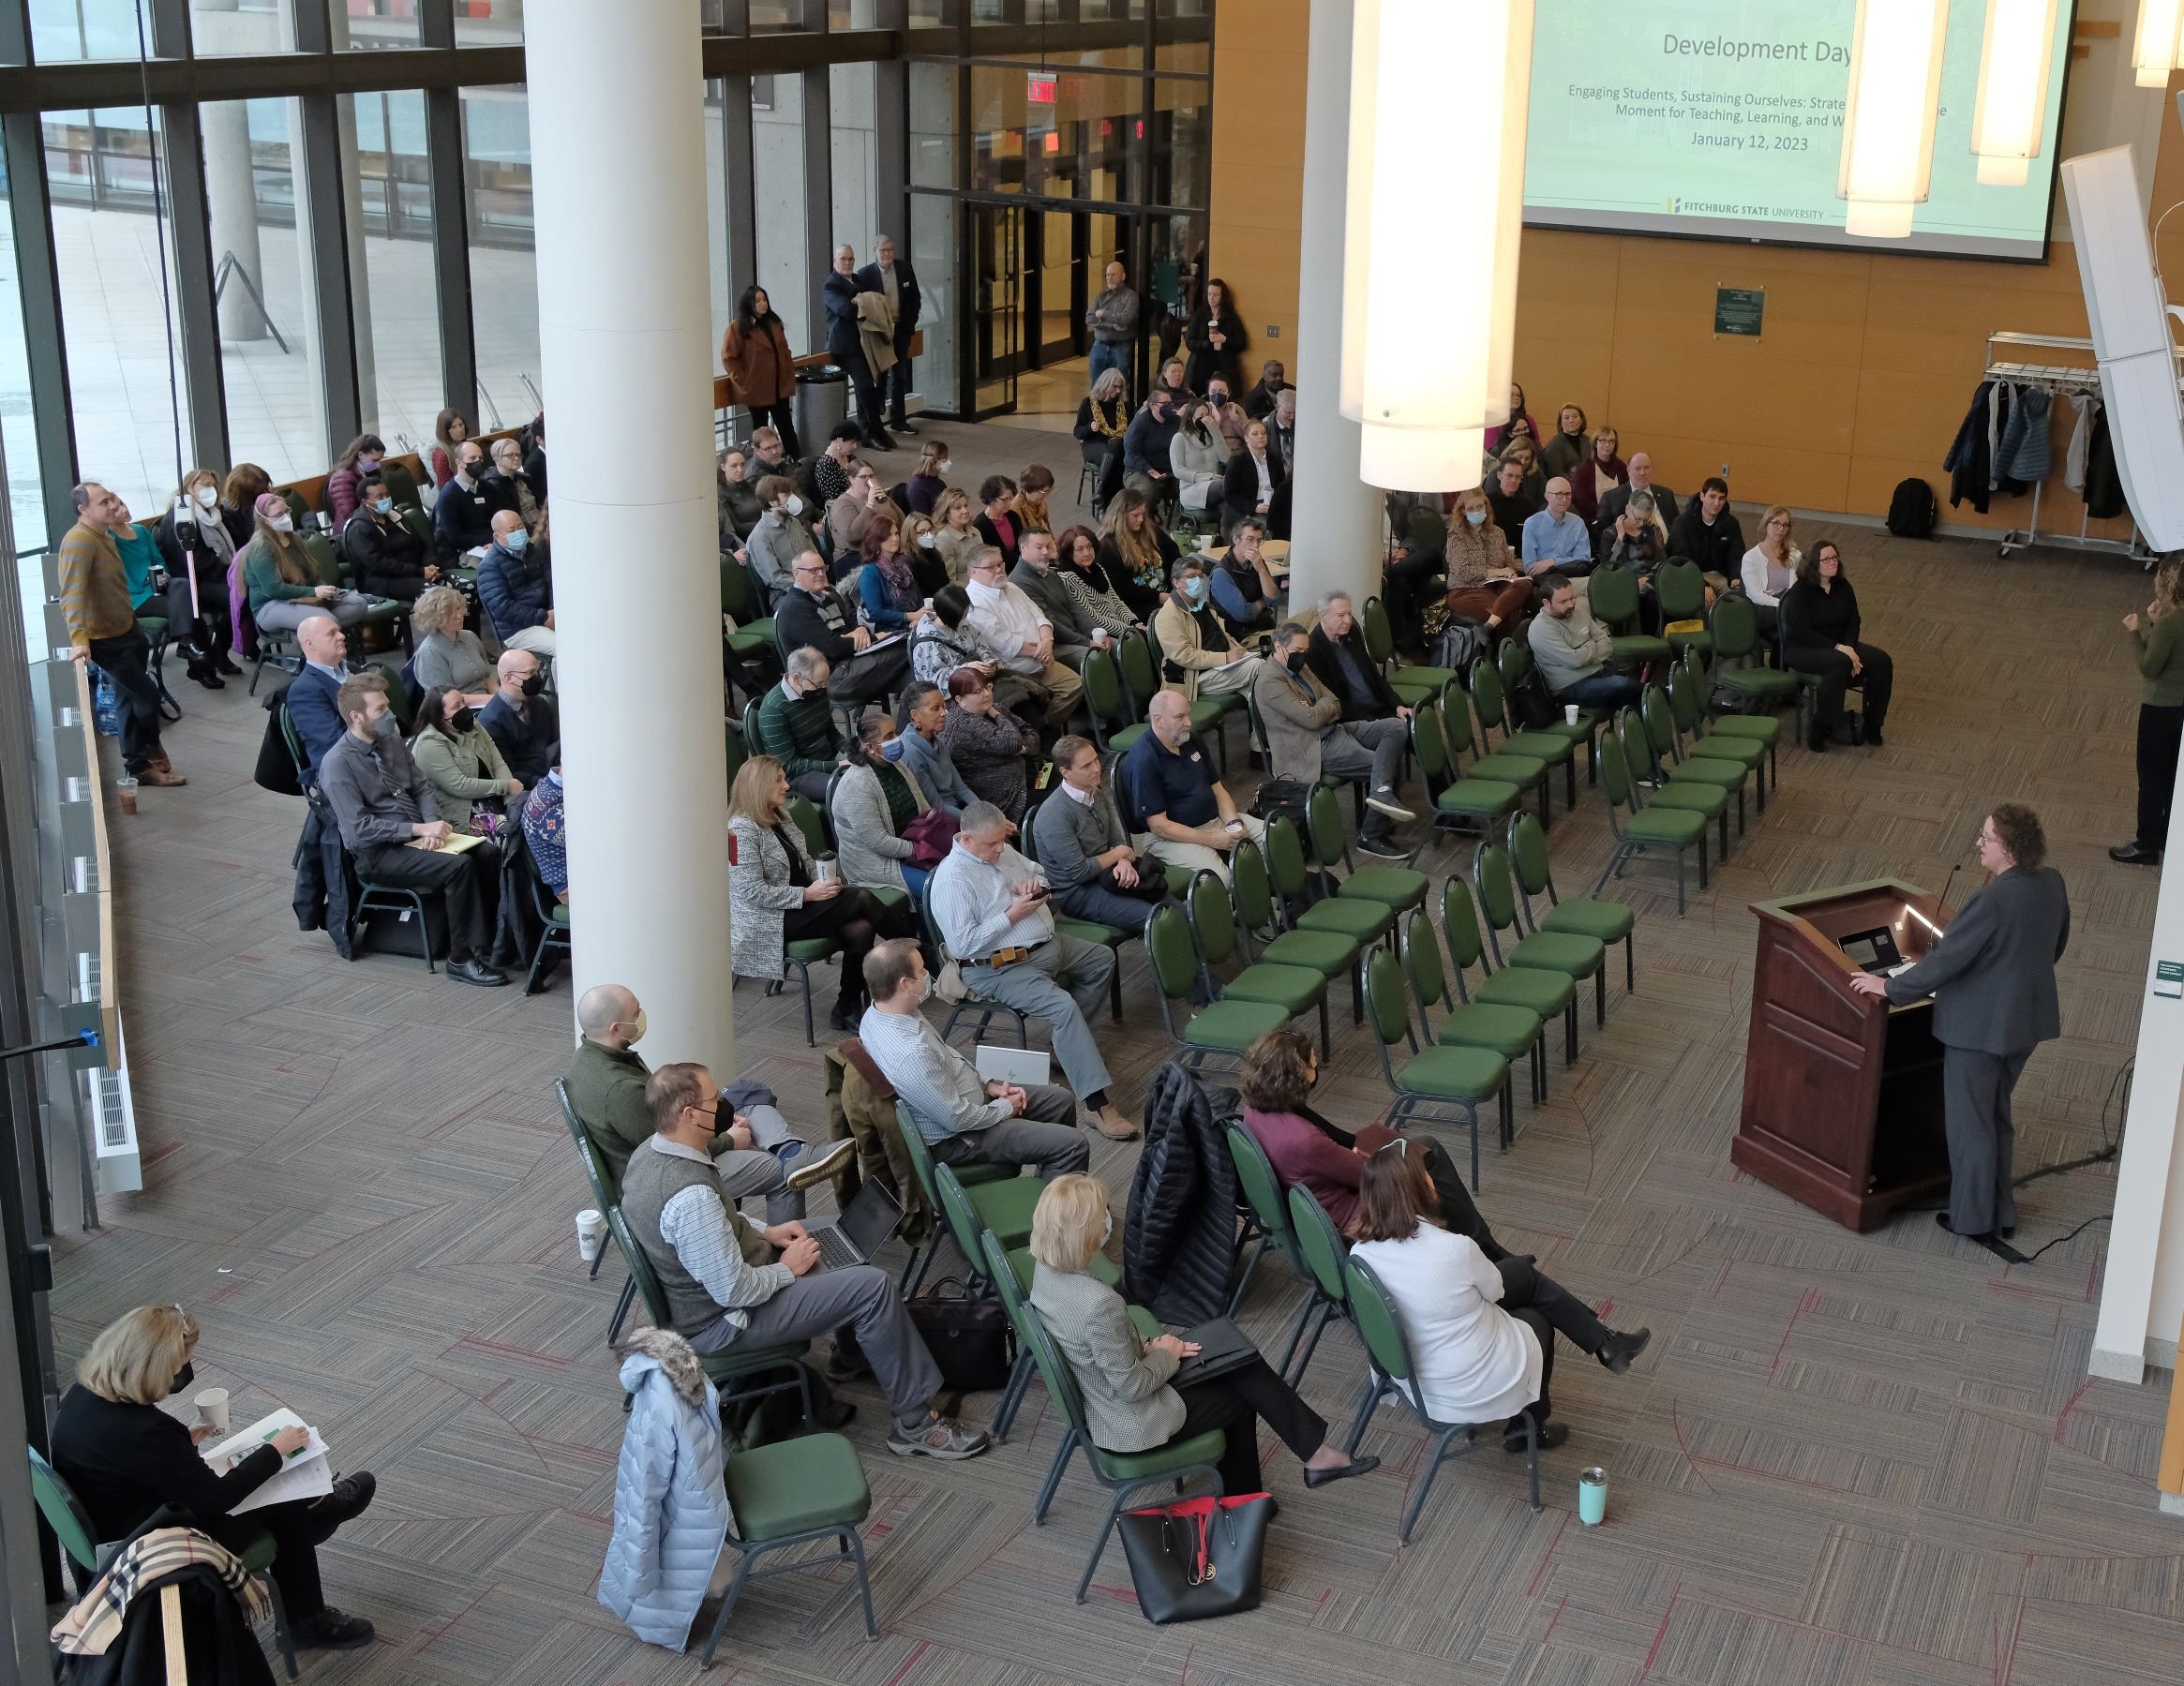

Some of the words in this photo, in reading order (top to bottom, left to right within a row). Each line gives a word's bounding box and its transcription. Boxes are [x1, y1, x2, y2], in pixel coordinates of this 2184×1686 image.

[1663, 34, 1809, 62] Development
[1815, 41, 1852, 67] Day
[1568, 84, 1620, 100] Engaging
[1623, 87, 1678, 103] Students,
[1681, 90, 1742, 107] Sustaining
[1744, 93, 1806, 109] Ourselves:
[1810, 97, 1846, 110] Strate
[1615, 104, 1666, 118] Moment
[1669, 106, 1685, 119] for
[1689, 108, 1743, 124] Teaching,
[1747, 111, 1802, 127] Learning,
[1805, 114, 1829, 127] and
[1691, 132, 1744, 150] January
[1749, 134, 1770, 151] 12,
[1773, 136, 1808, 151] 2023
[1684, 201, 1739, 214] FITCHBURG
[1742, 205, 1769, 216] STATE
[1772, 207, 1824, 219] UNIVERSITY
